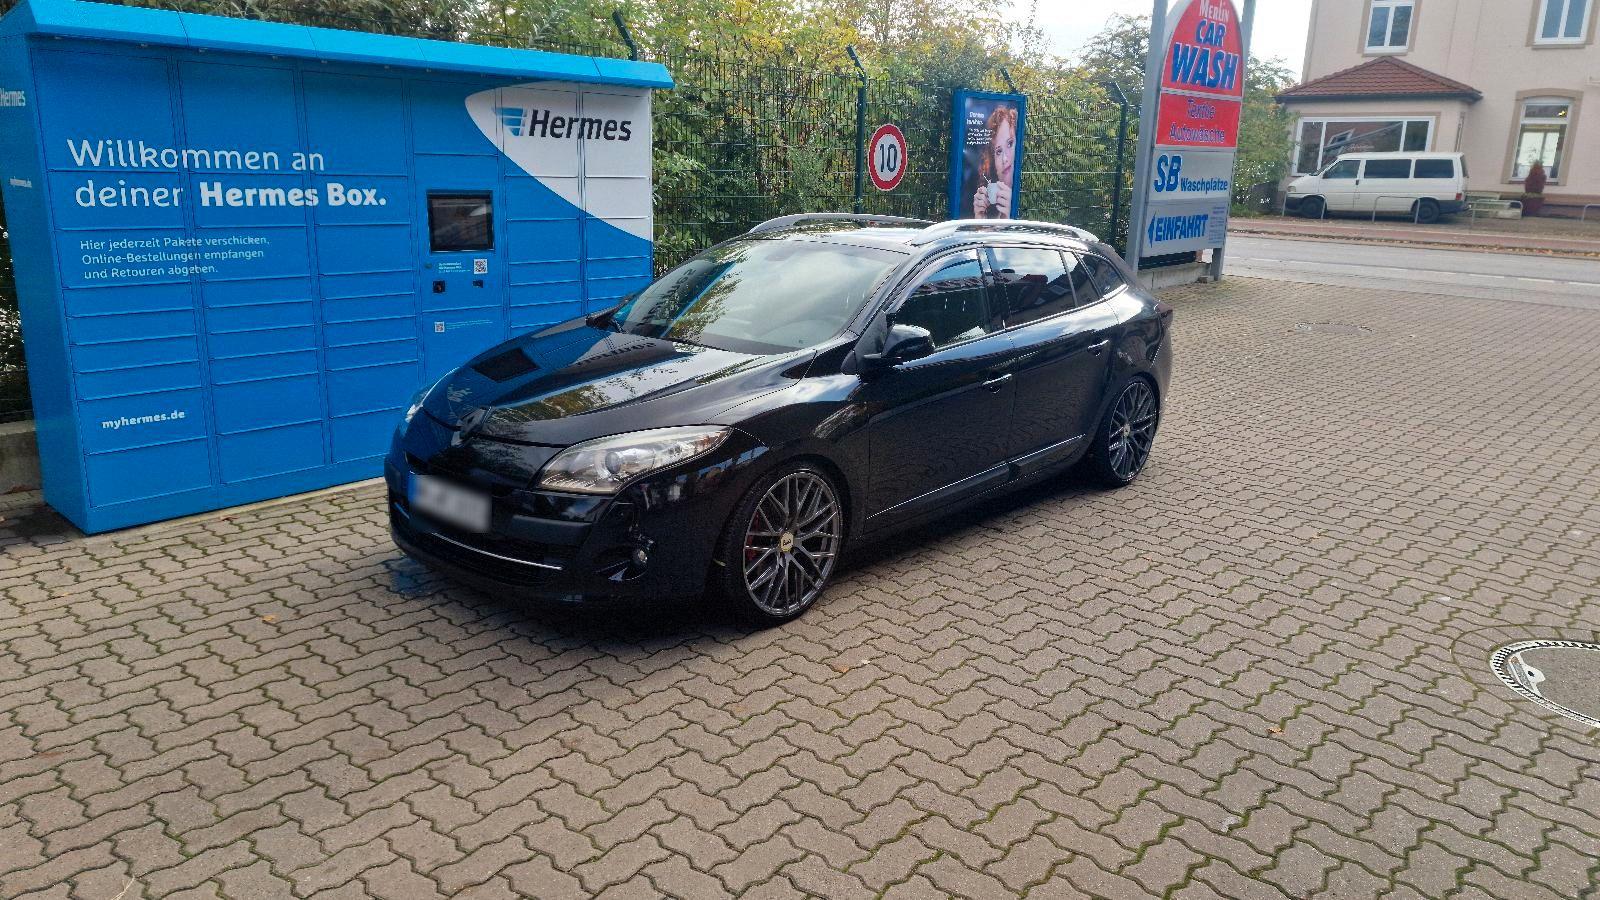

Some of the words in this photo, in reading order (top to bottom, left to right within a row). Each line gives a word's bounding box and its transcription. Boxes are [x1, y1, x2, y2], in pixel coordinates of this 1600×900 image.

[1195, 19, 1227, 48] CAR
[1171, 42, 1239, 90] WASH
[528, 109, 632, 142] Hermes
[67, 139, 279, 171] Willkommen
[291, 150, 325, 171] an
[879, 143, 898, 173] 10
[1154, 154, 1182, 192] SB
[75, 180, 184, 207] deiner
[200, 182, 319, 207] Hermes
[326, 183, 388, 207] Box.
[1155, 214, 1209, 242] EINFAHRT
[80, 239, 106, 251] Hier
[108, 238, 161, 252] jederzeit
[164, 237, 203, 248] Pakete
[205, 236, 270, 246] verschicken,
[81, 251, 201, 265] Online-Bestellungen
[204, 249, 265, 261] empfangen
[84, 268, 107, 280] und
[111, 267, 165, 278] Retouren
[168, 264, 219, 277] abgeben.
[102, 410, 186, 430] myhermes.de
